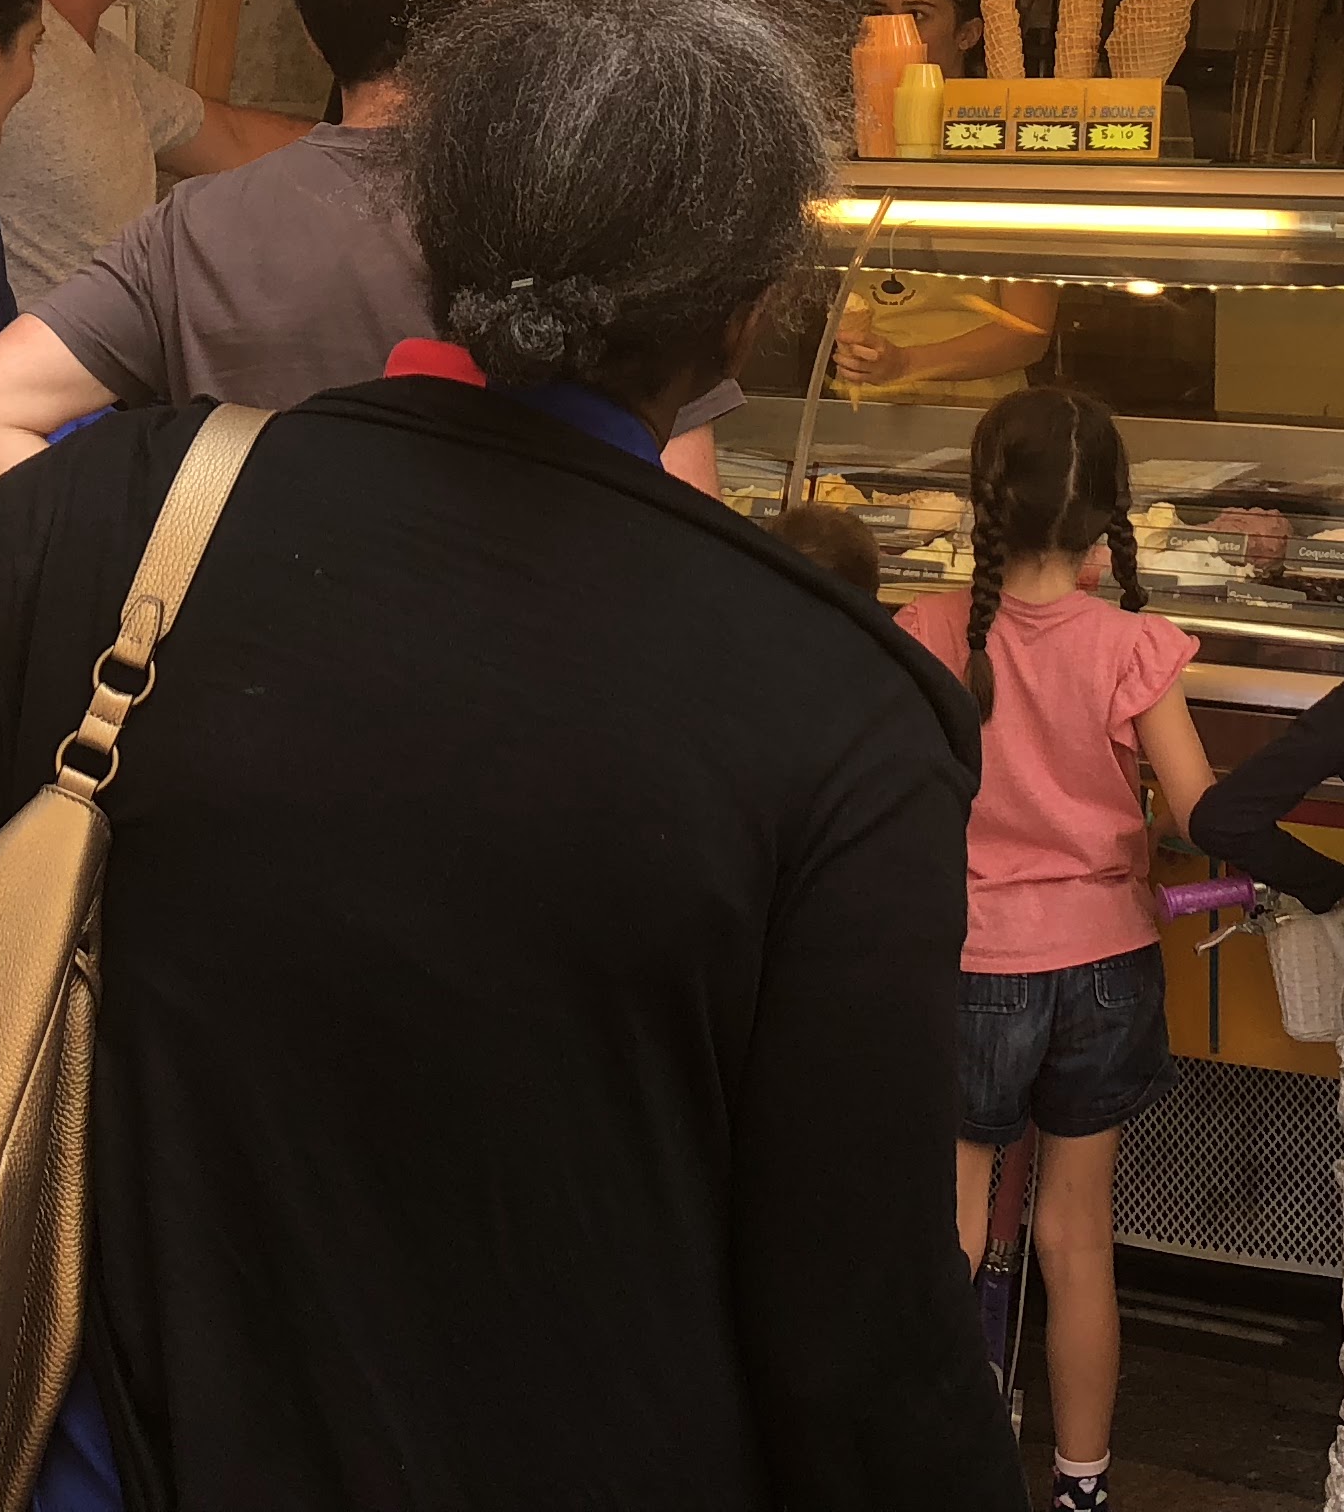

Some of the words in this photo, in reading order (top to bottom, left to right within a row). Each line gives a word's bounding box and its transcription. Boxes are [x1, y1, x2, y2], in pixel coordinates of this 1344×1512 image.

[957, 106, 1002, 118] BOULE
[1023, 106, 1078, 118] BOULES
[1099, 106, 1156, 119] BOULES
